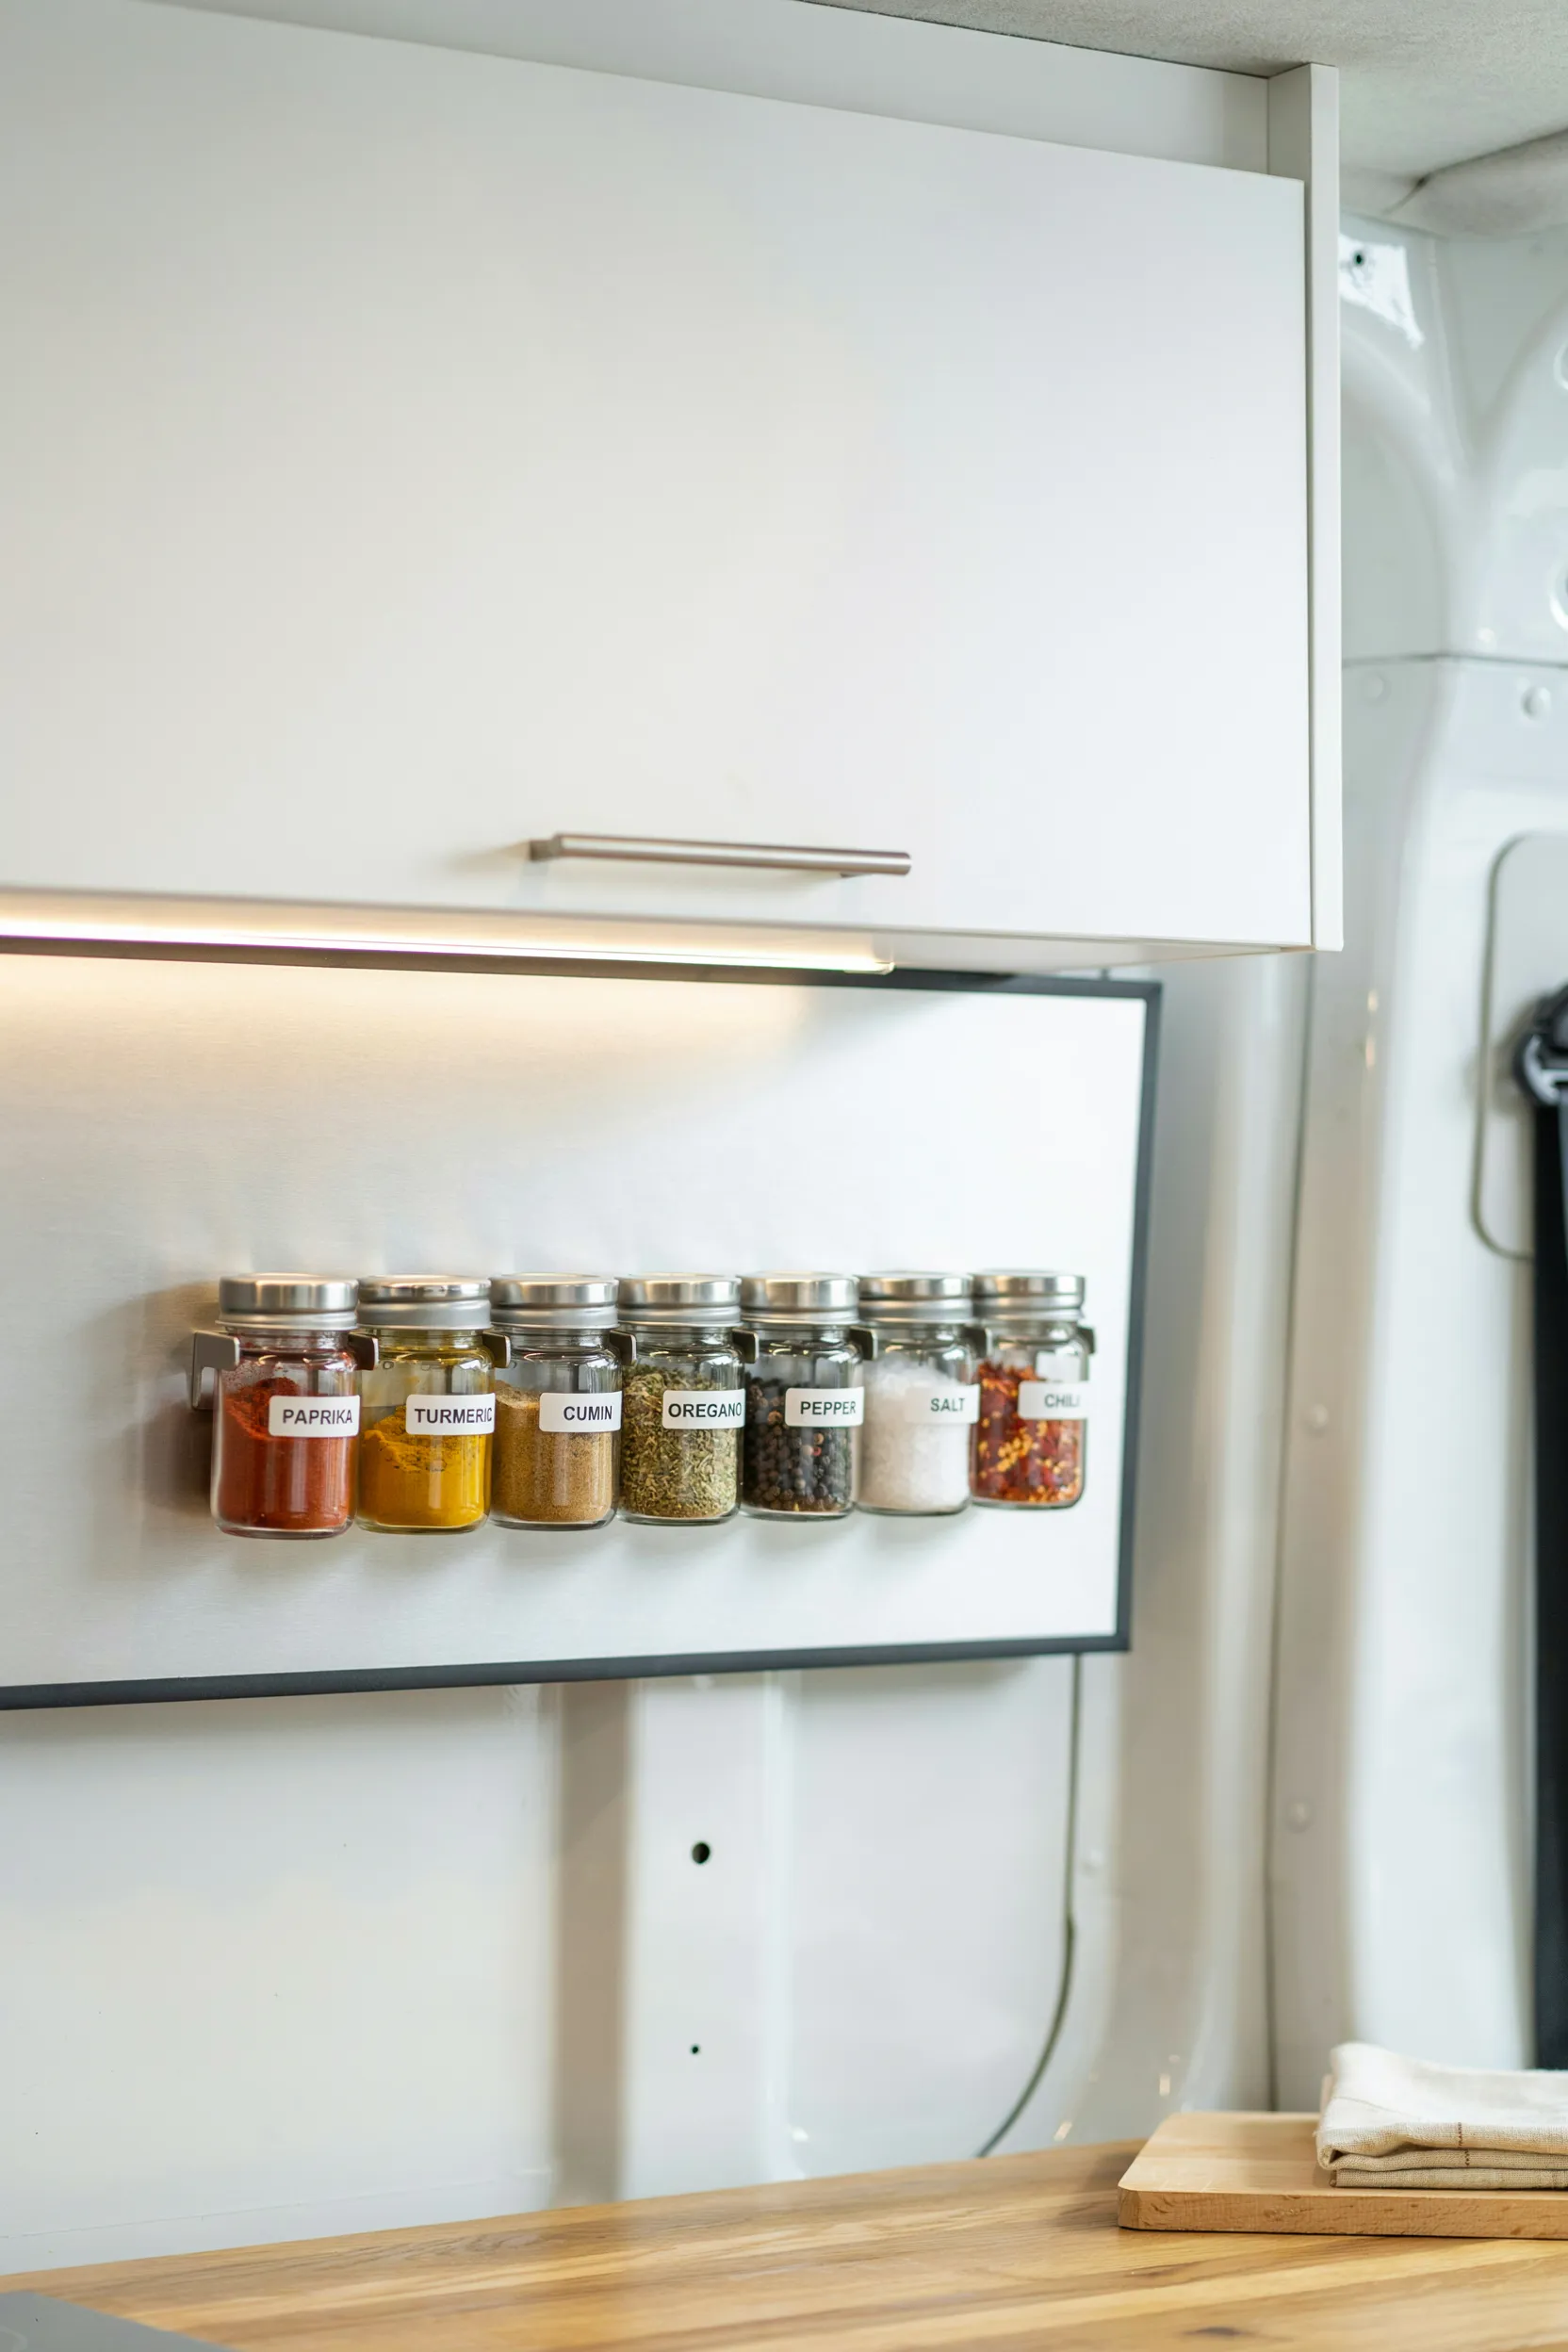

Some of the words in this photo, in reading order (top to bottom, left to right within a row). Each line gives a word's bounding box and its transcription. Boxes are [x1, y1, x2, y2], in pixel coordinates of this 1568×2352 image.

[563, 1405, 612, 1421] CUMIN
[668, 1403, 743, 1419] OREGANO
[800, 1401, 856, 1415] PEPPER
[930, 1397, 964, 1413] SALT
[283, 1408, 353, 1425] PAPRIKA
[415, 1407, 493, 1424] TURMERIC
